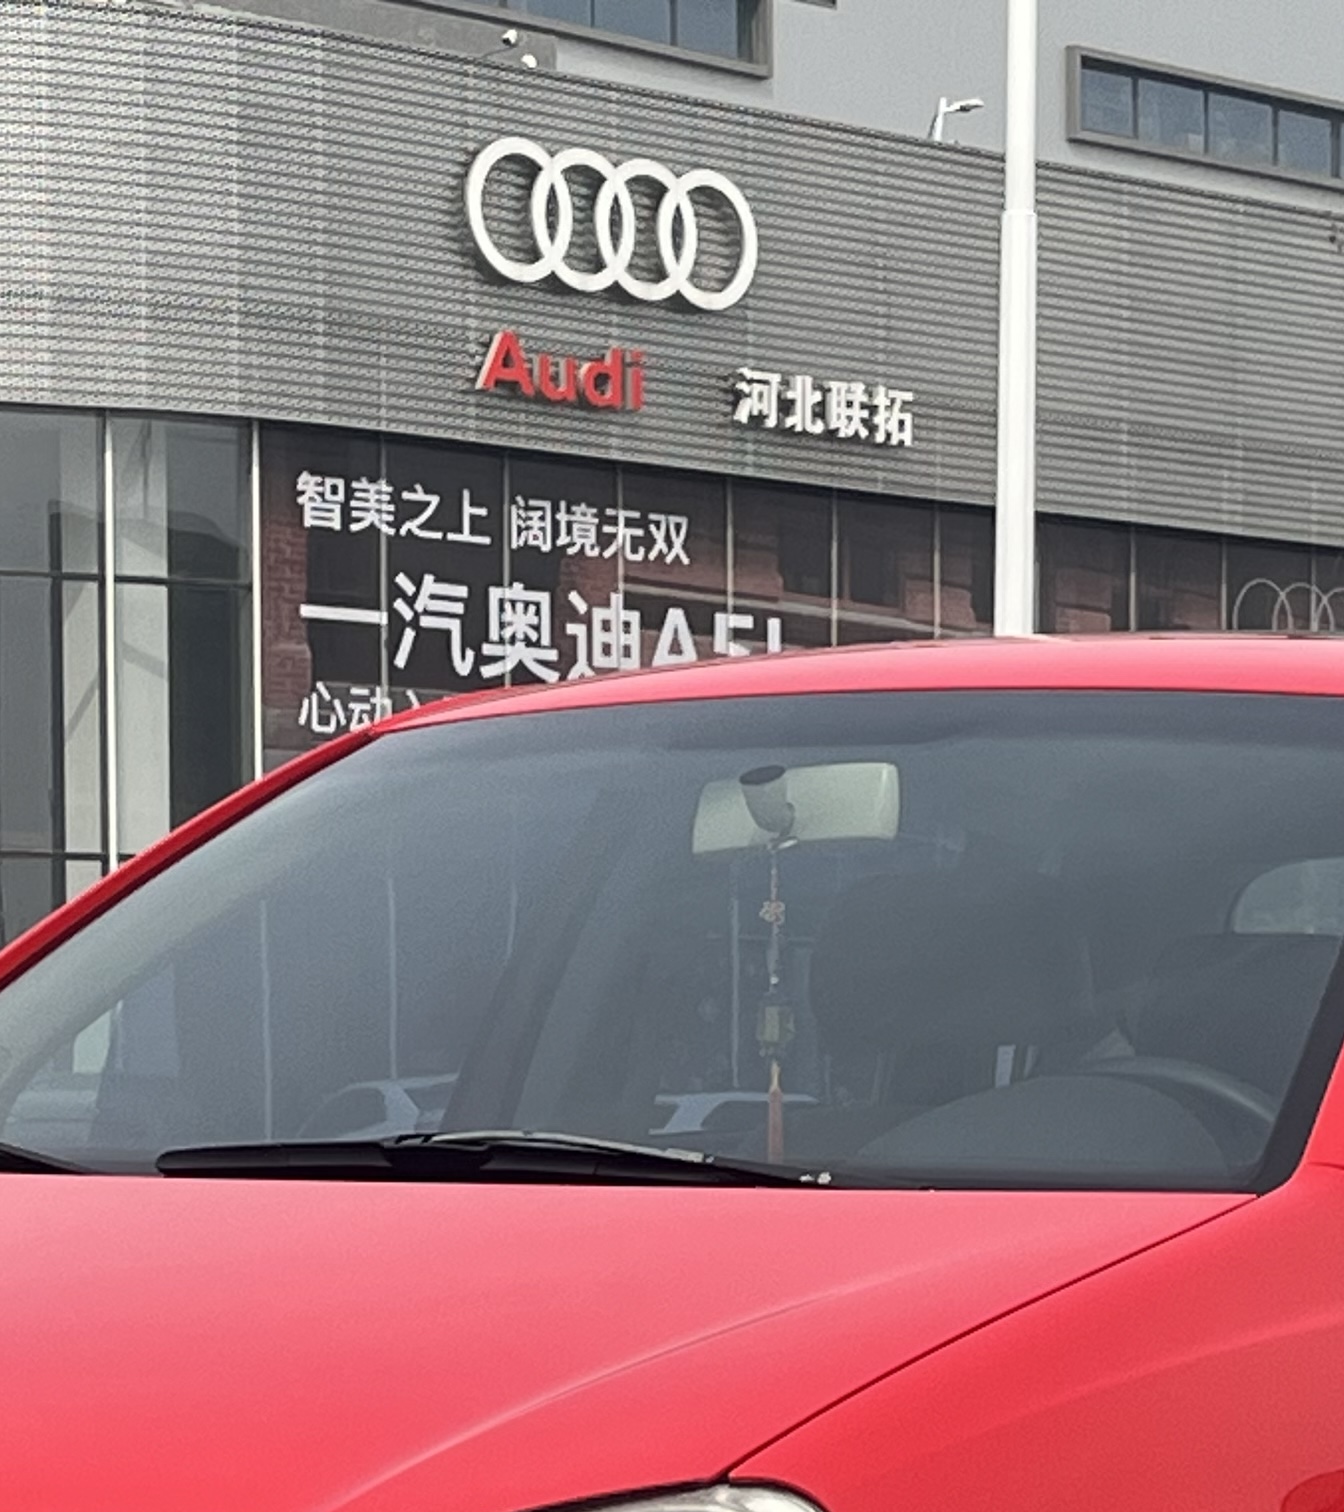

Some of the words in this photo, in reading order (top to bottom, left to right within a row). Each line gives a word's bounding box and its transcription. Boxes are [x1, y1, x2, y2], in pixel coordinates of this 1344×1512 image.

[475, 329, 646, 411] Audi
[733, 367, 915, 447] 河北联拓
[296, 470, 492, 547] 智美之上
[510, 494, 690, 566] 阔境无双
[298, 681, 420, 734] 心动
